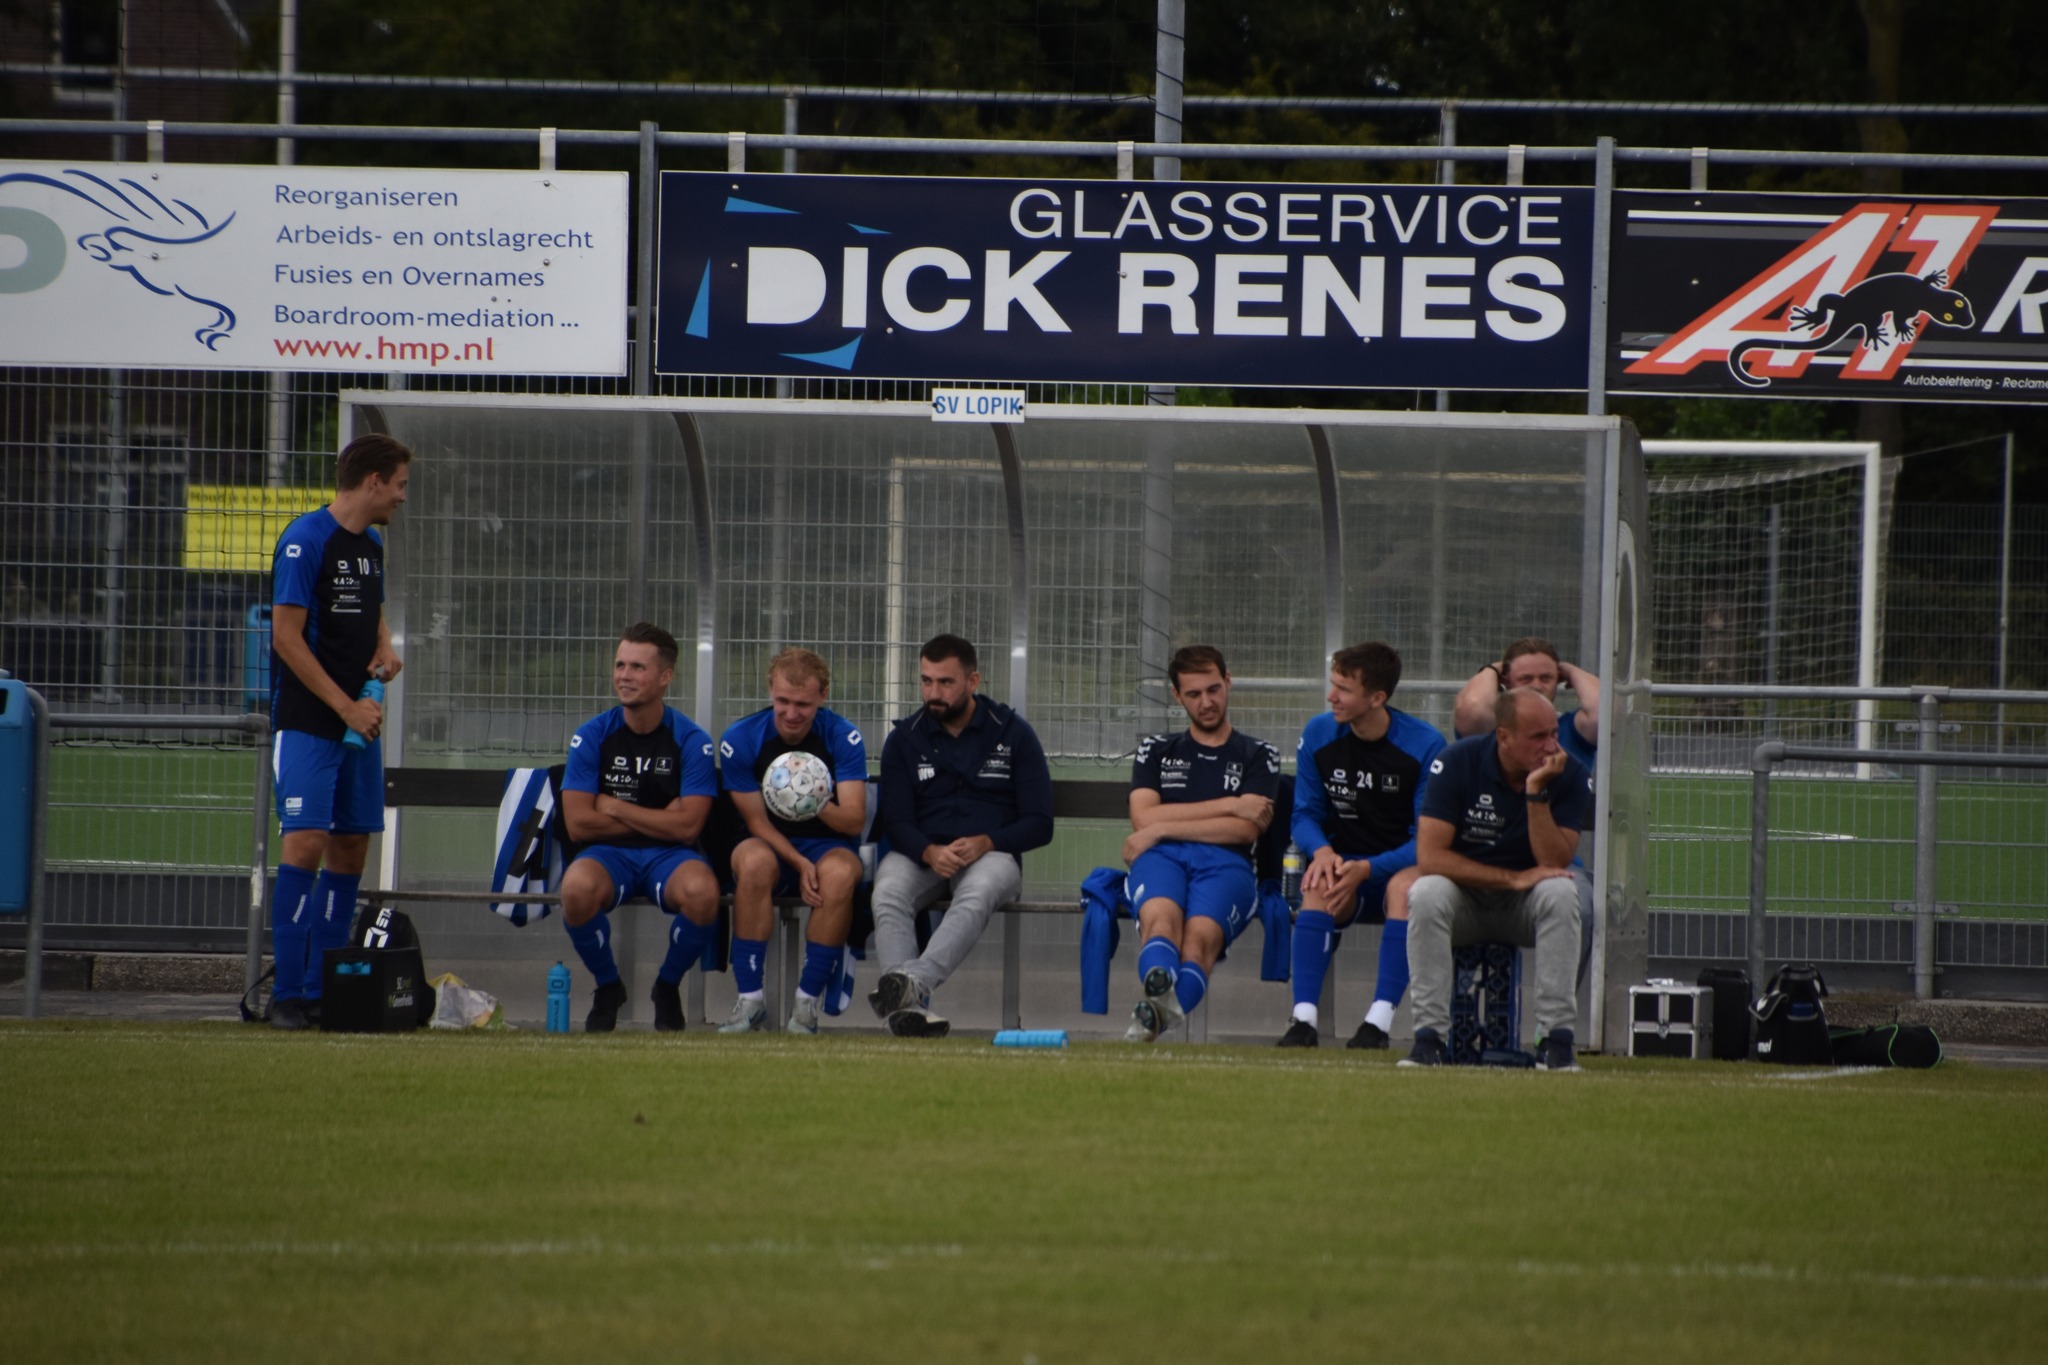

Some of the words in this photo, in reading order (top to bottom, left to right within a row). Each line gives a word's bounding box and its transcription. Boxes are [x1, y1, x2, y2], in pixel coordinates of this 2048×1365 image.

[276, 184, 459, 210] Reorganiseren
[1010, 188, 1562, 246] GLASSERVICE
[276, 224, 382, 245] Arbeids-
[393, 231, 424, 246] en
[433, 228, 594, 252] ontslagrecht
[275, 264, 353, 285] Fusies
[362, 270, 393, 286] en
[403, 265, 545, 288] Overnames
[746, 246, 1072, 334] DICK
[1118, 251, 1567, 342] RENES
[1623, 202, 2001, 381] A1
[275, 304, 555, 328] Boardroom-mediation
[275, 337, 495, 367] www.hmp.nl
[1903, 374, 1993, 390] Autobelettering
[934, 396, 959, 414] SV
[966, 396, 1021, 415] LOPIK
[356, 557, 370, 576] 10
[1223, 774, 1241, 792] 19
[1356, 769, 1374, 790] 24
